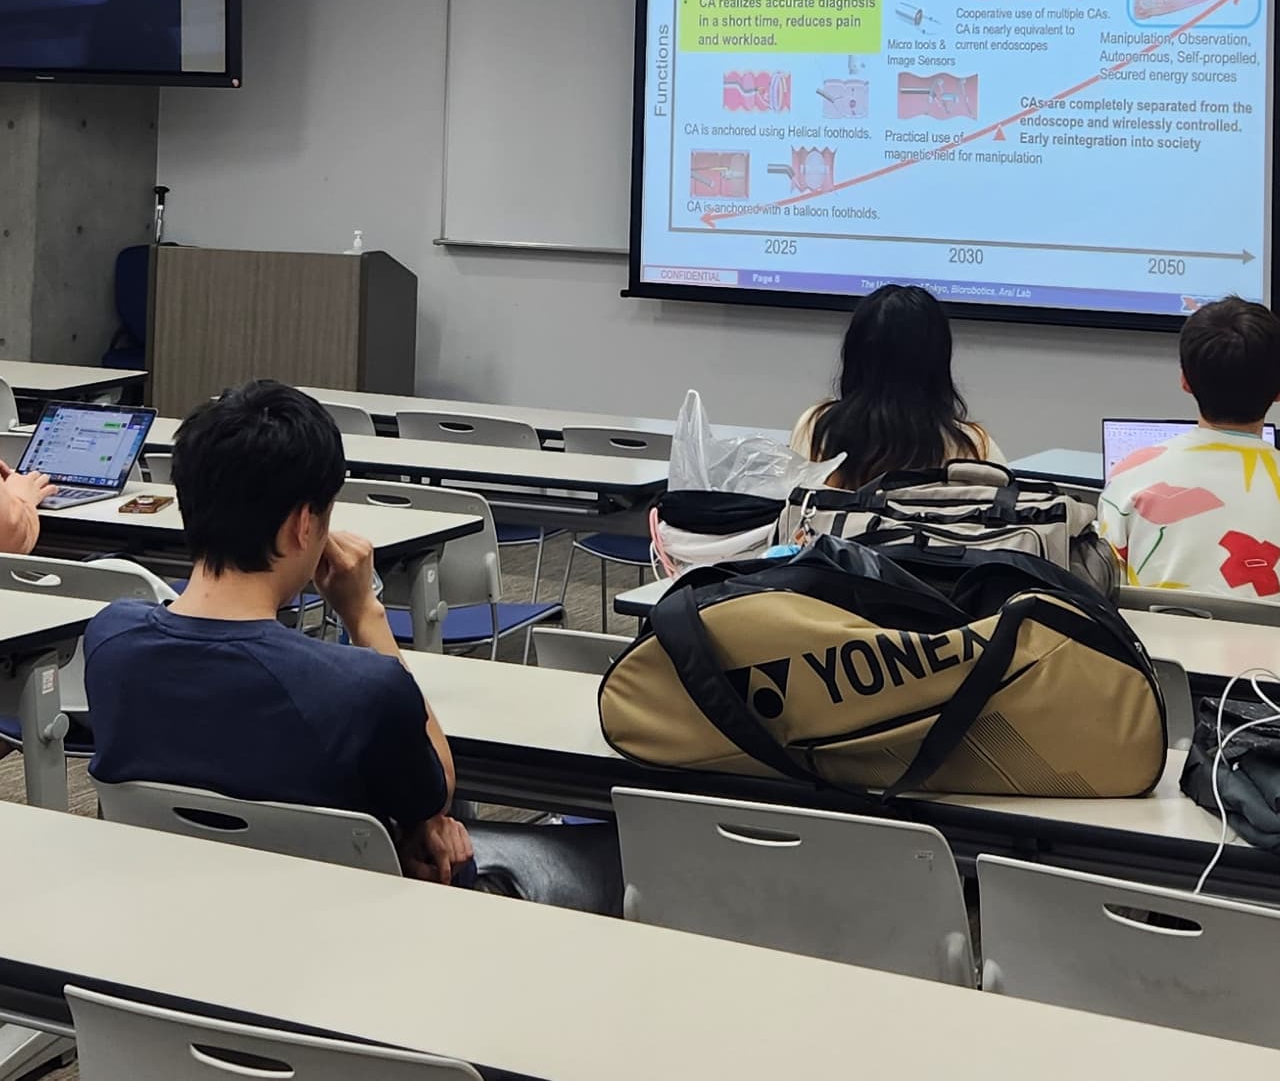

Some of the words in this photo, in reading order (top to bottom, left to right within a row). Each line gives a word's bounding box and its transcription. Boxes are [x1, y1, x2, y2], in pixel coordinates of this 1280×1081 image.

[699, 15, 709, 27] in
[712, 18, 720, 27] a
[723, 15, 752, 27] short
[754, 15, 782, 29] time,
[786, 15, 832, 27] reduces
[836, 15, 861, 30] pain
[956, 8, 1012, 21] Cooperative
[1014, 10, 1032, 19] use
[1035, 8, 1045, 19] of
[1047, 8, 1084, 21] multiple
[1087, 8, 1111, 20] CAs.
[698, 33, 719, 45] and
[722, 33, 777, 45] workload.
[955, 24, 971, 35] CA
[972, 24, 980, 35] is
[983, 24, 1012, 37] nearly
[1014, 25, 1063, 38] equivalent
[1065, 25, 1075, 35] to
[887, 39, 912, 50] Micro
[914, 39, 937, 50] tools
[939, 39, 946, 50] &
[955, 40, 988, 51] current
[991, 40, 1048, 53] endoscopes
[1100, 32, 1174, 47] Manipulation,
[1178, 32, 1251, 48] Observation,
[887, 55, 916, 68] Image
[918, 55, 956, 66] Sensors
[1099, 50, 1174, 65] Autonomous,
[1177, 51, 1260, 66] Self-propelled,
[654, 24, 670, 117] Functions
[1099, 68, 1146, 81] Secured
[1149, 71, 1189, 84] energy
[1191, 72, 1237, 83] sources
[1020, 97, 1044, 109] CAs
[1047, 99, 1066, 109] are
[1069, 97, 1134, 113] completely
[1137, 99, 1197, 115] separated
[1200, 100, 1229, 114] from
[1232, 101, 1253, 114] the
[684, 124, 699, 135] CA
[701, 124, 709, 136] is
[712, 124, 756, 137] anchored
[759, 125, 785, 140] using
[788, 125, 821, 138] Helical
[823, 126, 872, 139] footholds.
[1020, 116, 1084, 129] endoscope
[1087, 116, 1109, 129] and
[1112, 117, 1173, 133] wirelessly
[1176, 119, 1242, 133] controlled.
[885, 130, 929, 143] Practical
[931, 134, 951, 143] use
[953, 132, 965, 144] of
[1020, 132, 1049, 147] Early
[1052, 134, 1127, 149] reintegration
[1131, 135, 1154, 148] into
[1157, 137, 1201, 152] society
[884, 149, 931, 162] magnetic
[934, 150, 955, 162] field
[958, 151, 973, 162] for
[975, 152, 1042, 167] manipulation
[687, 201, 702, 213] CA
[704, 201, 712, 213] is
[714, 202, 759, 215] anchored
[762, 202, 781, 215] with
[784, 206, 791, 216] a
[793, 204, 829, 217] balloon
[831, 205, 880, 220] footholds.
[765, 238, 797, 255] 2025
[948, 247, 984, 265] 2030
[1148, 257, 1185, 276] 2050
[660, 269, 721, 282] CONFIDENTIAL
[752, 273, 773, 284] Page
[861, 280, 875, 289] The
